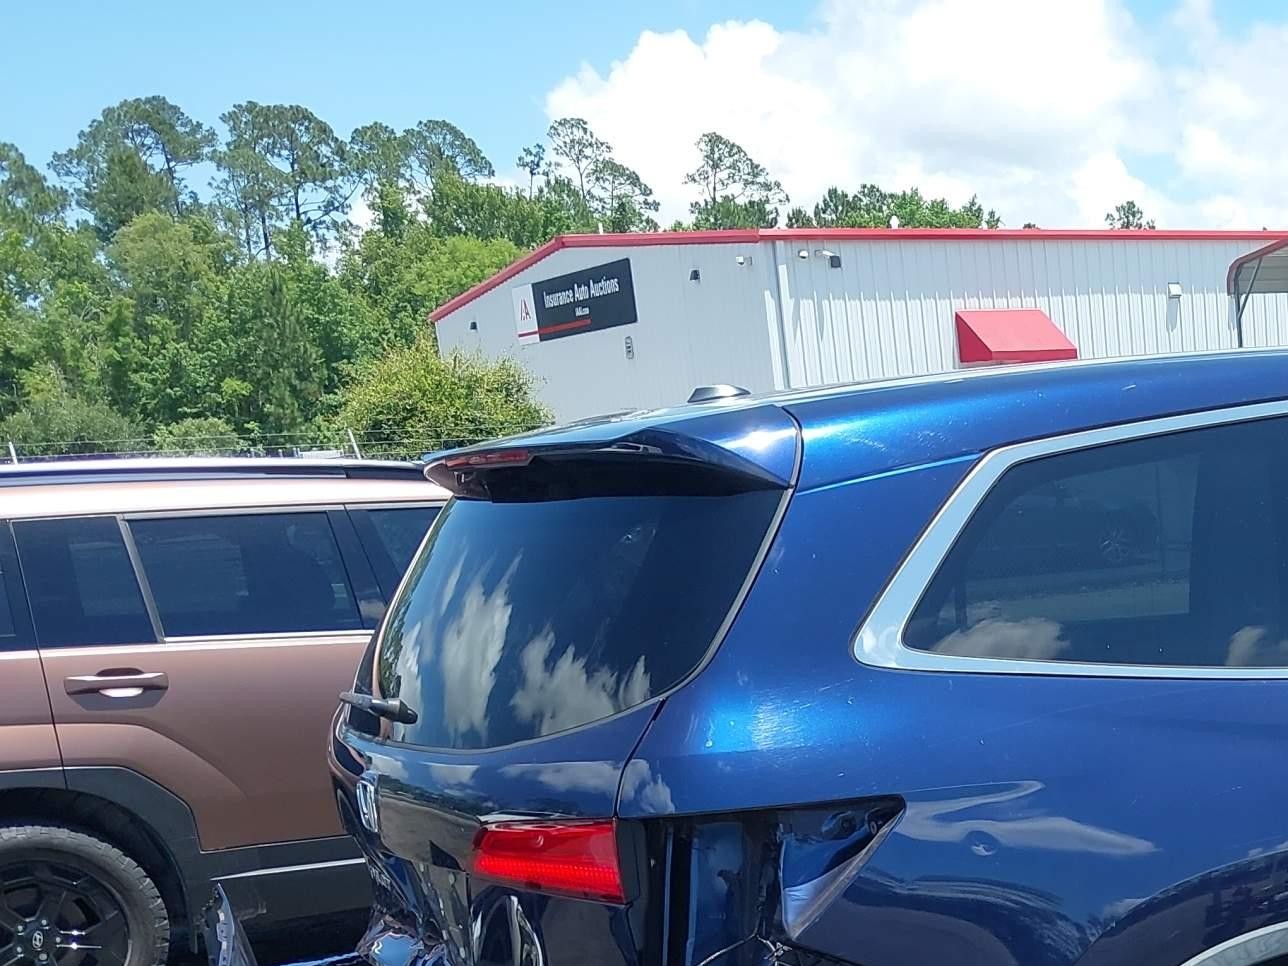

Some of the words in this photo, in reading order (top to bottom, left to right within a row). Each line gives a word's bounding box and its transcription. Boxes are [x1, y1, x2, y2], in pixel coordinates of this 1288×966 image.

[543, 287, 574, 309] Insurance
[573, 282, 590, 302] Auto
[589, 275, 620, 298] Auctions
